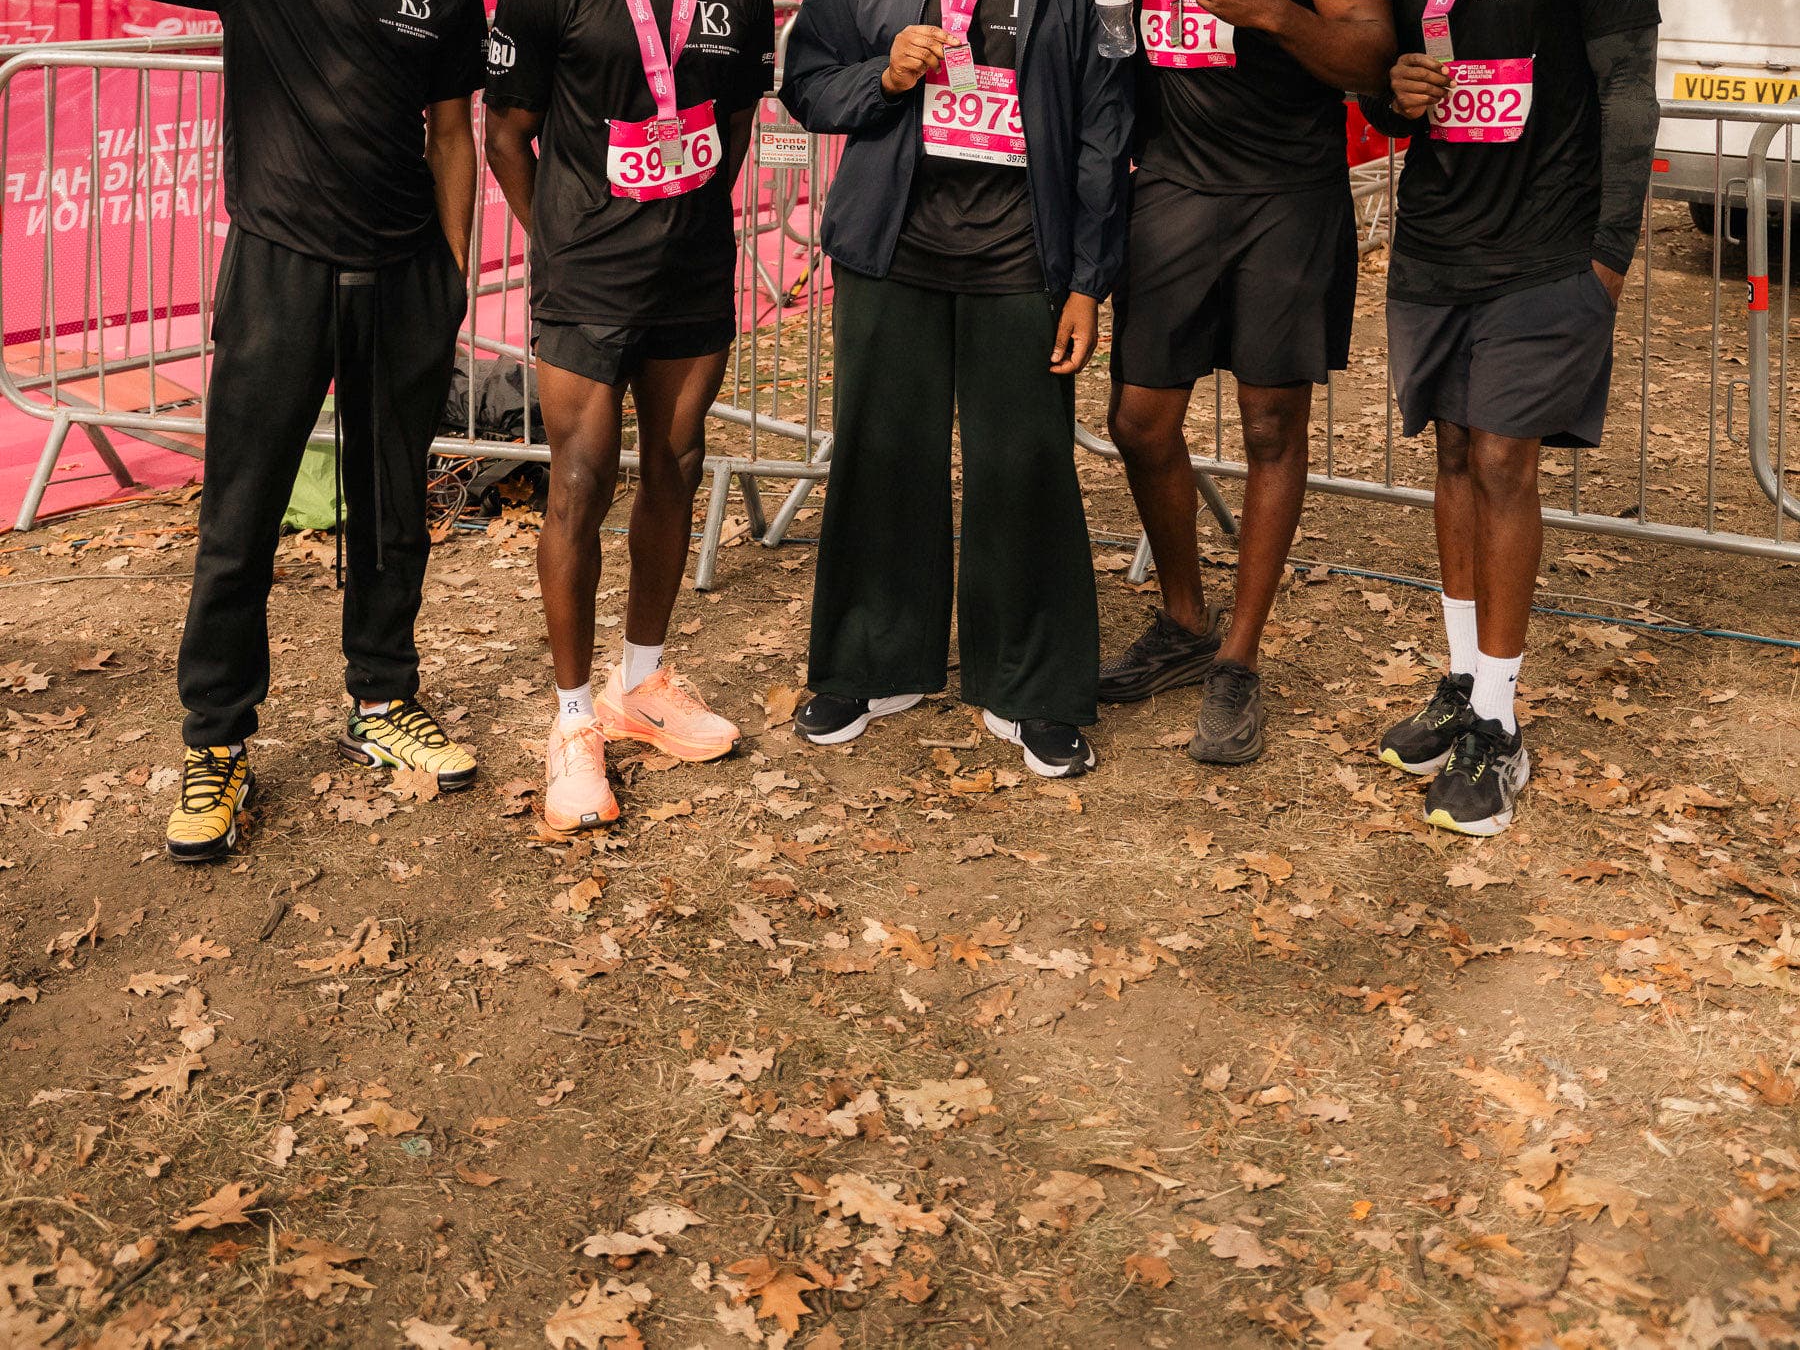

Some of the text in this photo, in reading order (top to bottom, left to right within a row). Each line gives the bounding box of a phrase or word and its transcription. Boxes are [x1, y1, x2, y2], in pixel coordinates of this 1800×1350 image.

[1685, 77, 1746, 101] VU55
[932, 90, 1024, 133] 3975
[1433, 88, 1522, 123] 3982
[761, 134, 807, 144] Events
[1006, 154, 1027, 164] 3975
